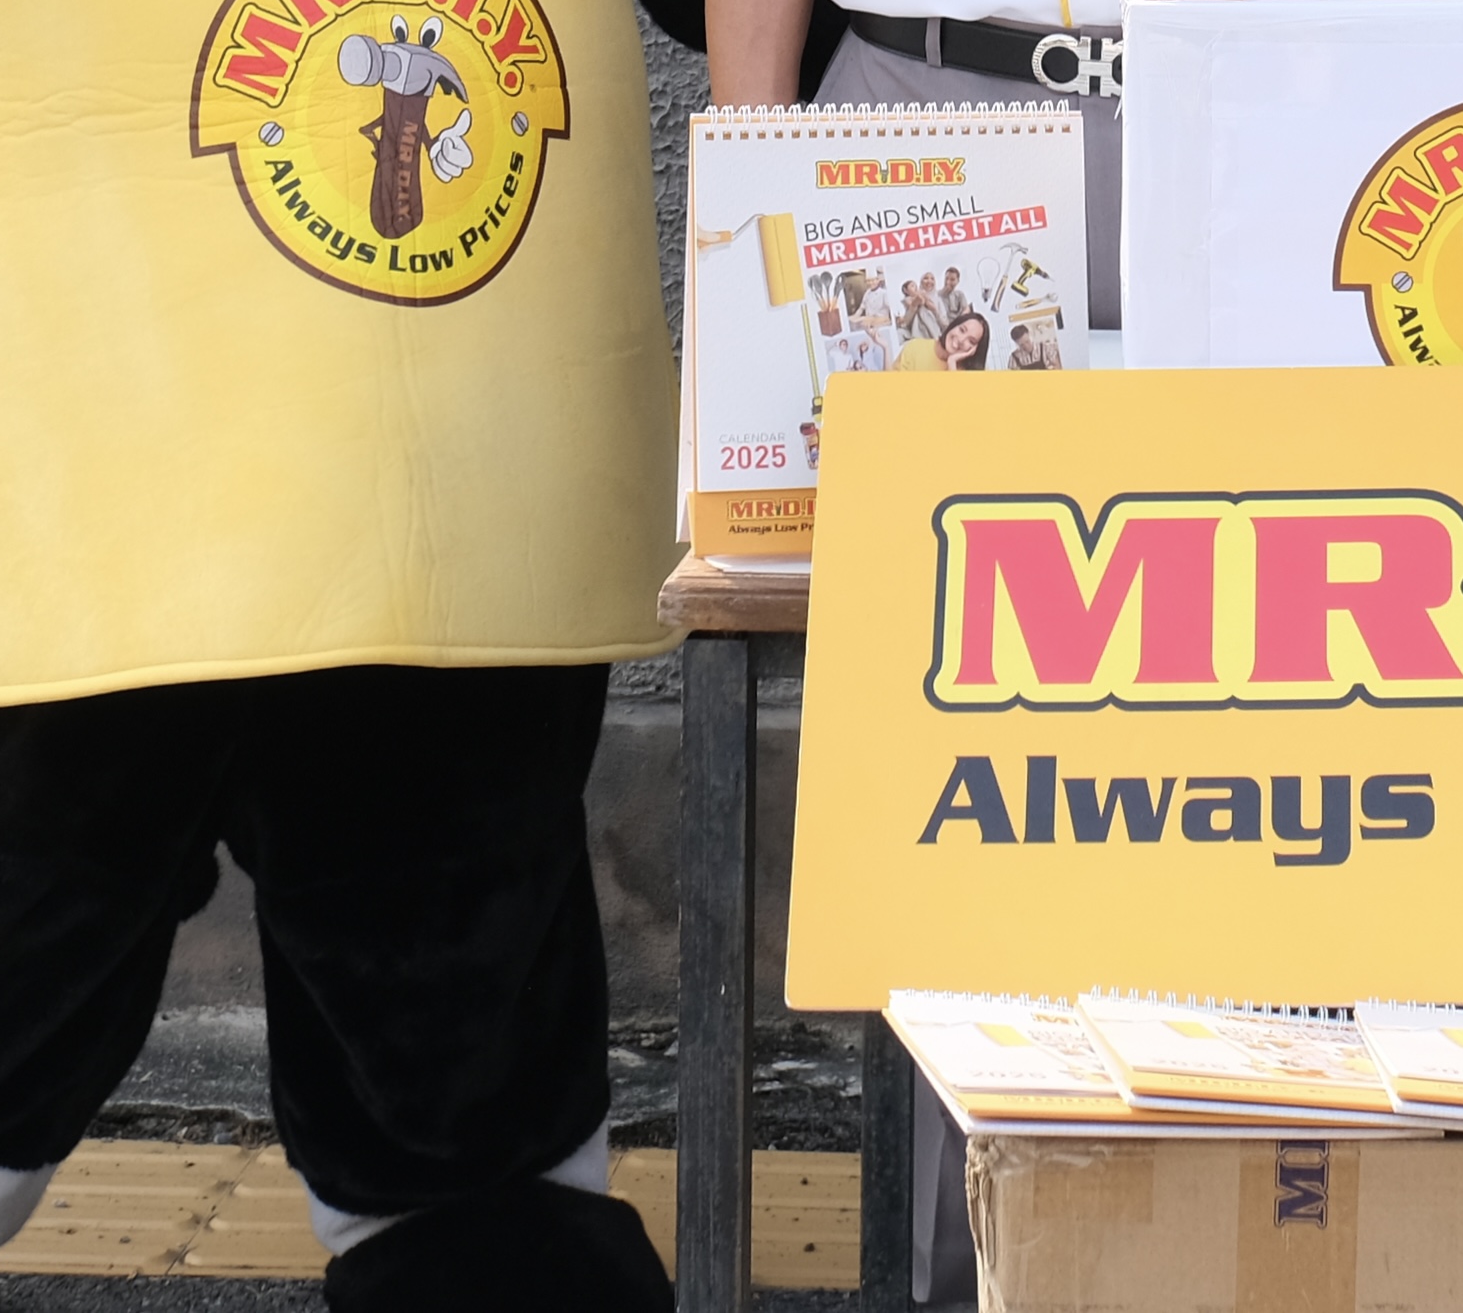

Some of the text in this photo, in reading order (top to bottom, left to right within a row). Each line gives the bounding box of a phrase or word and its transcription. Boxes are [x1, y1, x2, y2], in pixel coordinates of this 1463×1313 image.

[264, 150, 525, 274] Always Low Prices
[804, 196, 984, 243] BIG AND SMALL
[810, 208, 1043, 267] MR.D.I.Y. HAS IT ALL
[718, 432, 786, 443] CALENDAR
[720, 444, 787, 470] 2025
[917, 753, 1437, 868] Always
